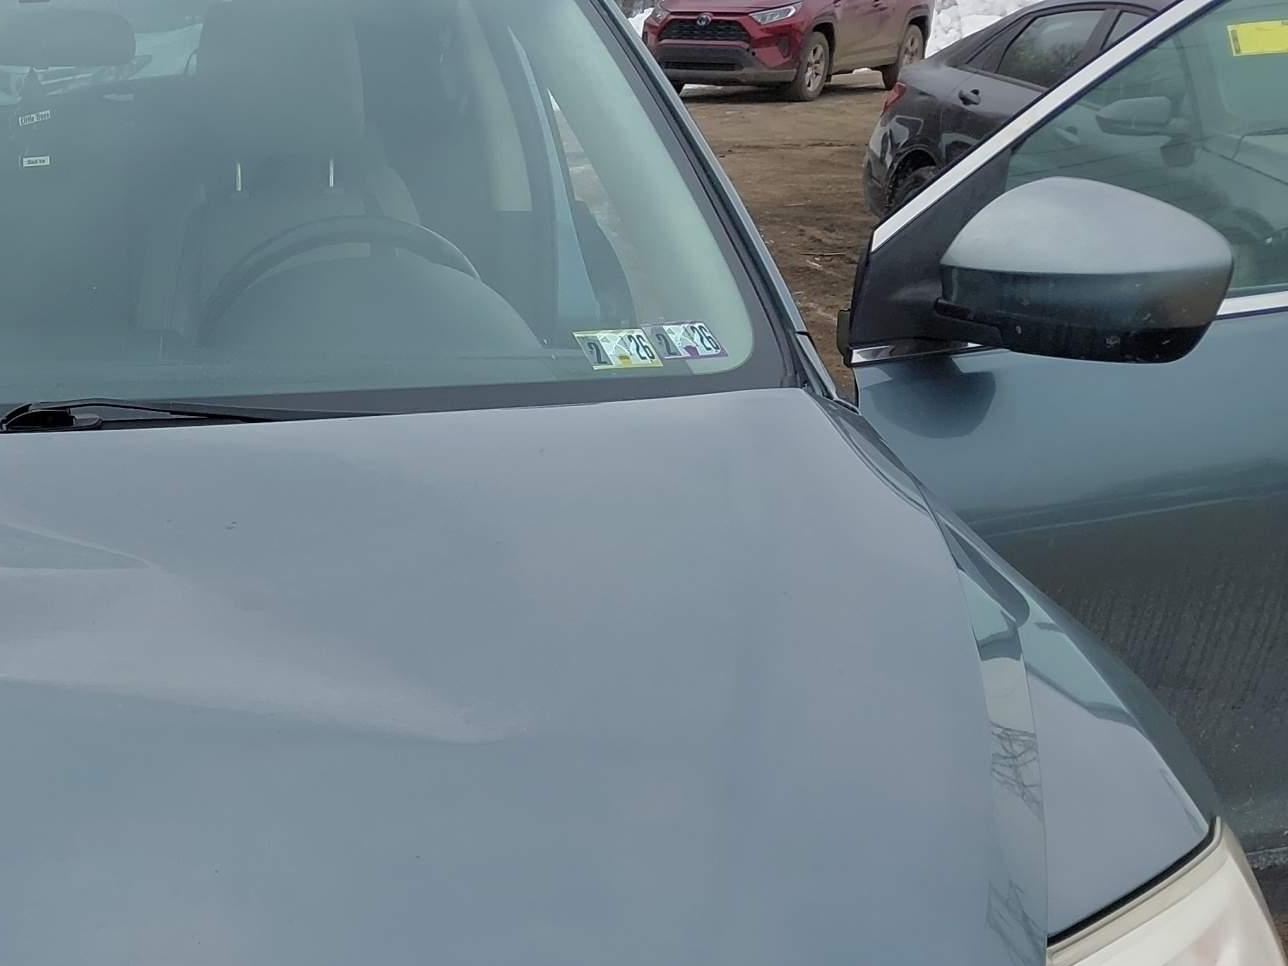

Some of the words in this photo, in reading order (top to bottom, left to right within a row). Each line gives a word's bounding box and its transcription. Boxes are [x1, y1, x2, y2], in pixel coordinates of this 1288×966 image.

[587, 342, 608, 364] 2
[627, 334, 656, 360] 26
[656, 333, 678, 356] 2
[690, 325, 720, 351] 26
